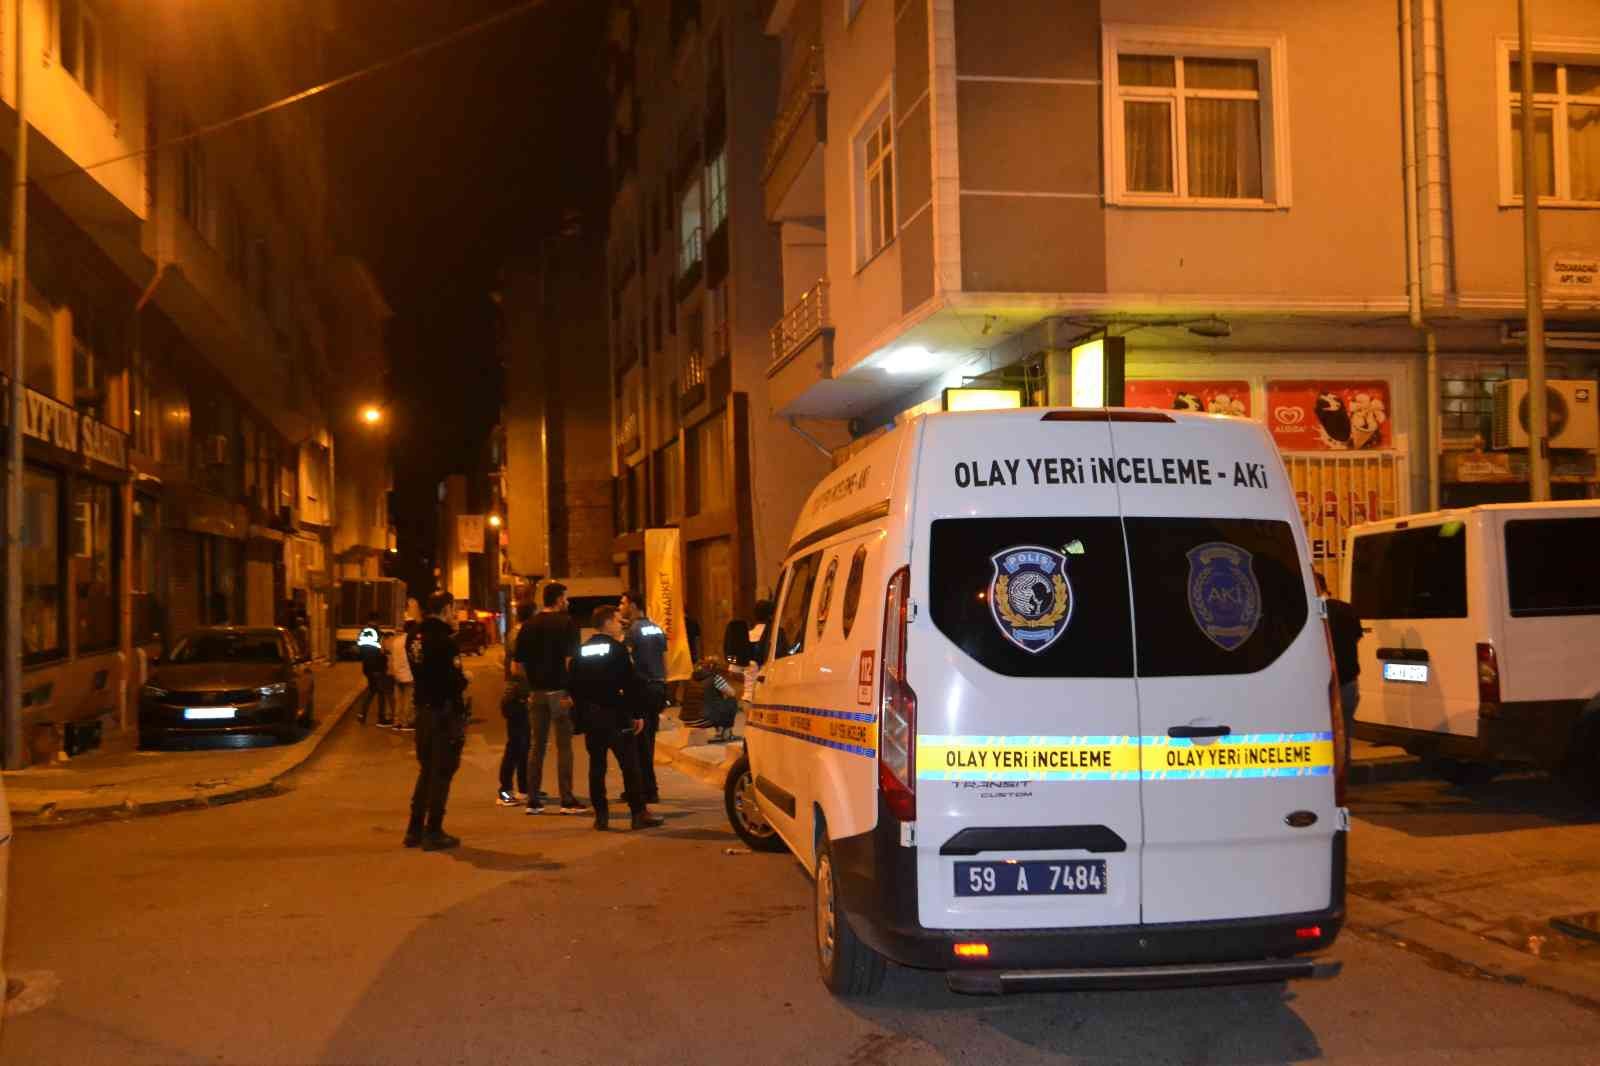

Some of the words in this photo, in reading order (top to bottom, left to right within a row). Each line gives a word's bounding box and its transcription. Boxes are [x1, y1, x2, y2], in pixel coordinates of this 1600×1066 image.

[954, 458, 1020, 488] OLAY
[946, 750, 987, 768] OLAY
[1166, 750, 1205, 767] OLAY
[980, 791, 1033, 799] CUSTOM
[968, 866, 996, 892] 59
[1016, 866, 1029, 891] A
[1049, 865, 1101, 891] 7484
